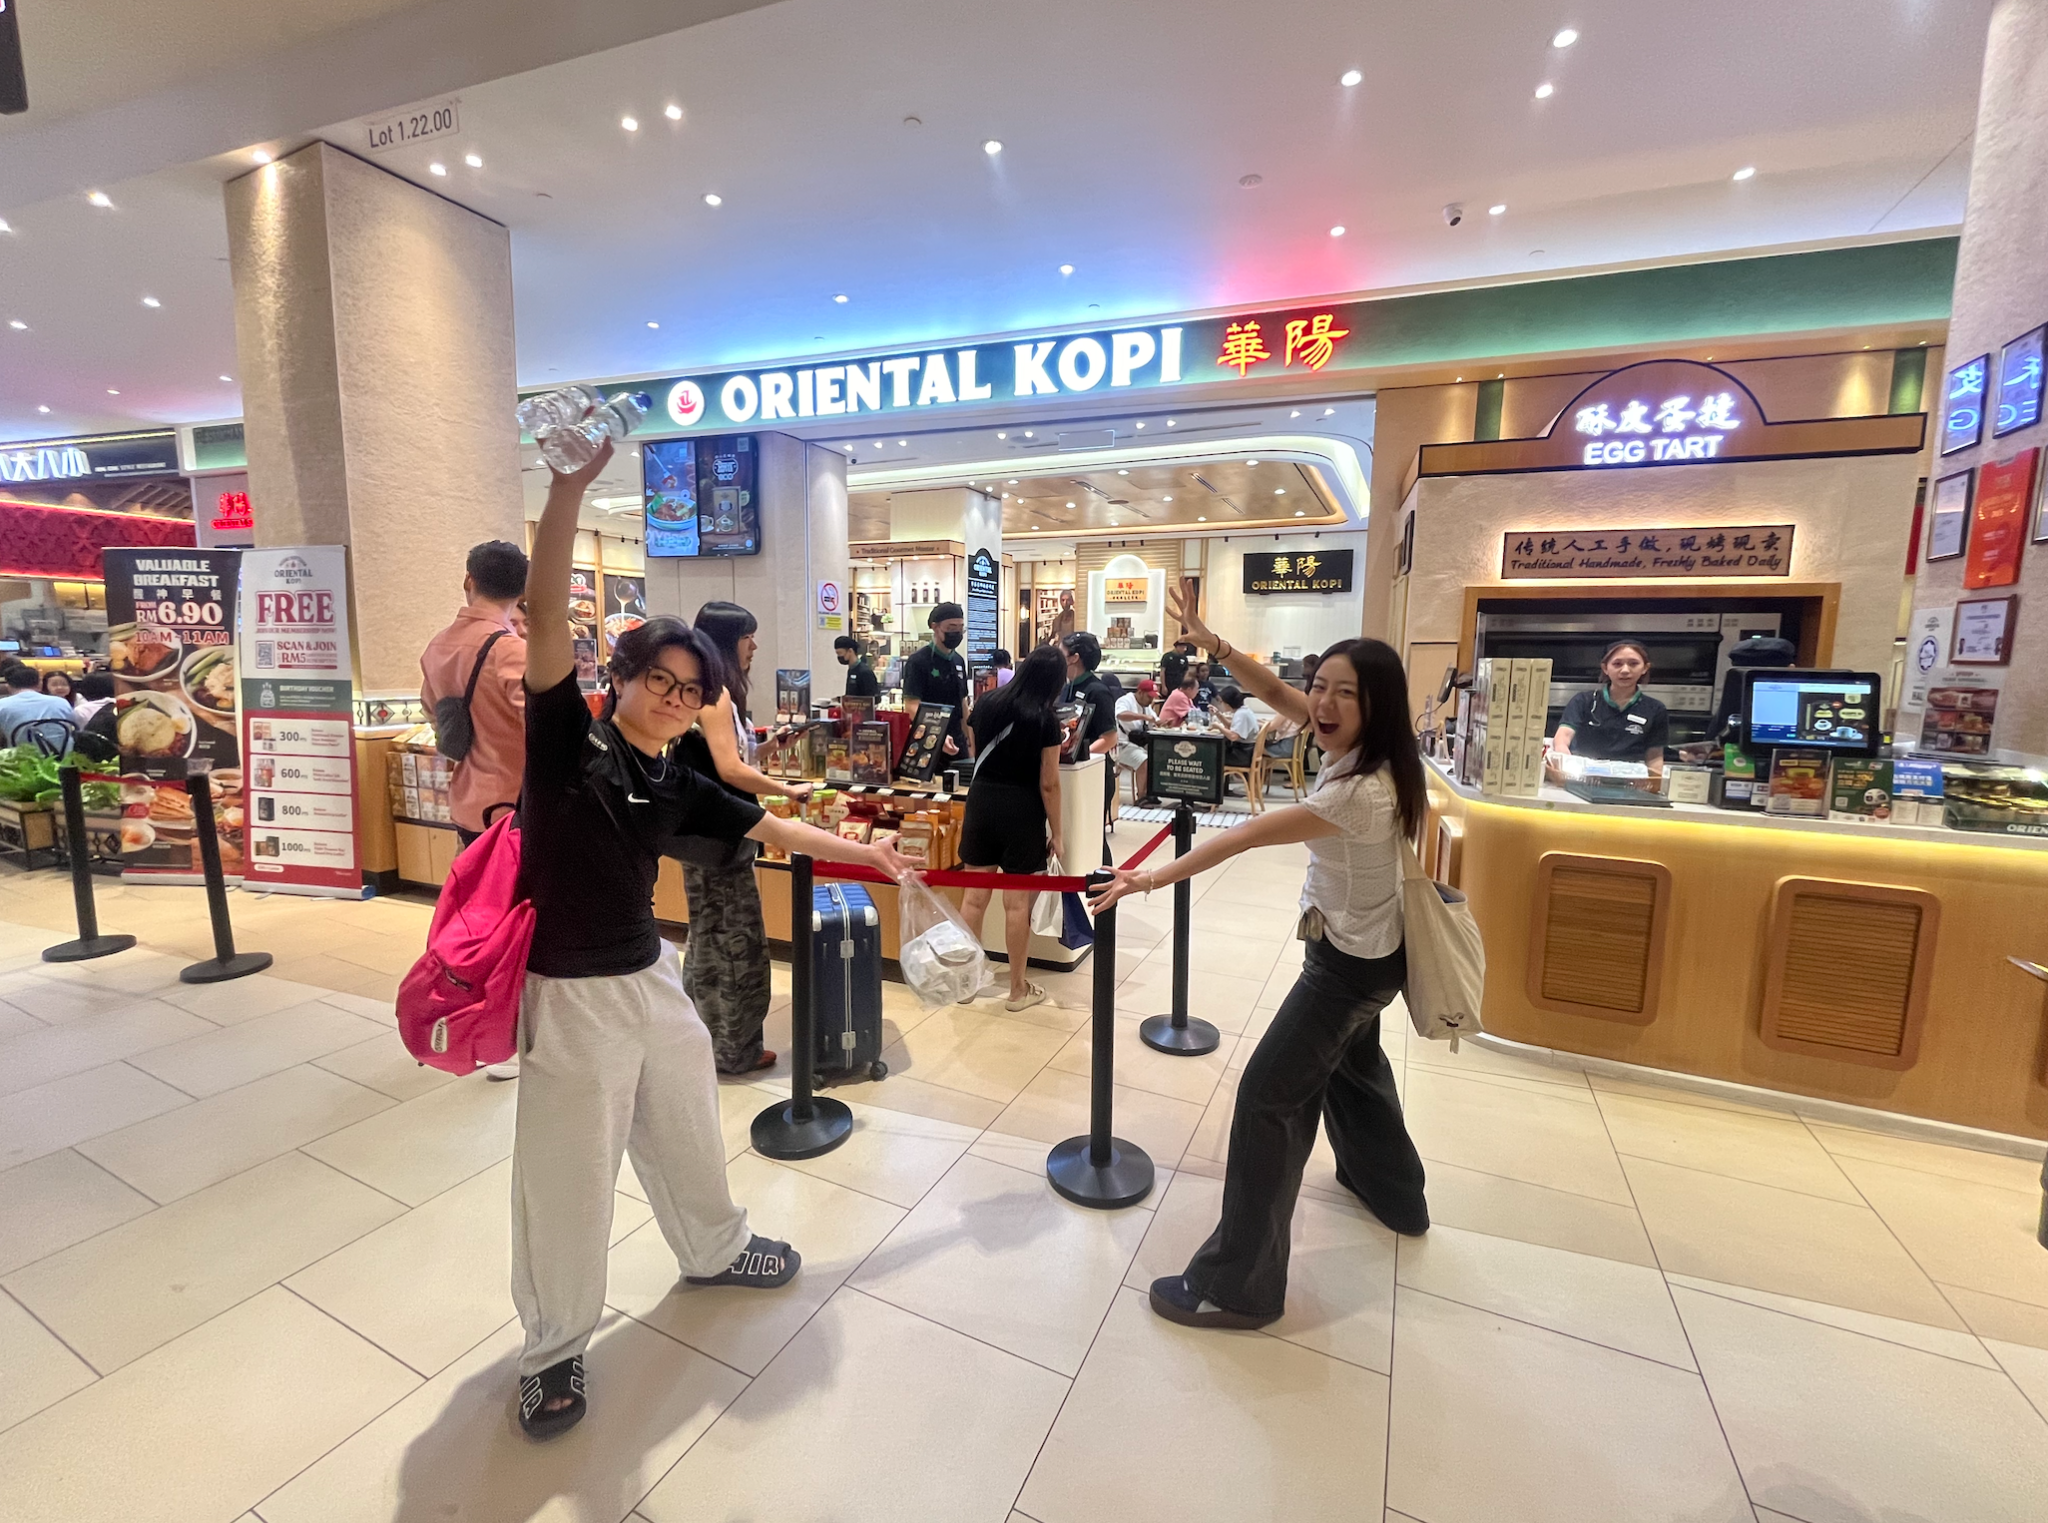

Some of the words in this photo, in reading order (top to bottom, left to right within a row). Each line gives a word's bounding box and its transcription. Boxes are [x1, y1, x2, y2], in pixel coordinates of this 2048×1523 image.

[369, 125, 394, 148] Lot
[398, 108, 452, 141] 1.22.00
[1217, 313, 1350, 377] 華陽
[720, 349, 992, 423] ORIENTAL
[1013, 327, 1183, 395] KOPI
[1584, 440, 1646, 465] EGG
[1649, 435, 1724, 461] TART
[135, 559, 211, 572] VALUABLE
[1271, 555, 1322, 578] 華陽
[1511, 557, 1574, 570] Traditional
[1579, 557, 1647, 569] Handmade,
[1652, 556, 1696, 571] Freshly
[1701, 555, 1741, 567] Baked
[1747, 554, 1783, 571] Daily
[274, 569, 313, 578] ORIENTAL
[133, 574, 219, 587] BREAKFAST
[1251, 579, 1309, 591] ORIENTAL
[1312, 578, 1343, 589] KOPI
[256, 591, 335, 625] FREE
[277, 641, 304, 651] SCAN
[306, 642, 313, 651] &
[313, 641, 337, 651] JOIN
[282, 653, 306, 663] RM5
[280, 731, 299, 742] 300
[1168, 758, 1188, 766] PLEASE
[281, 768, 300, 779] 600
[282, 805, 301, 816] 800
[282, 842, 304, 852] 1000
